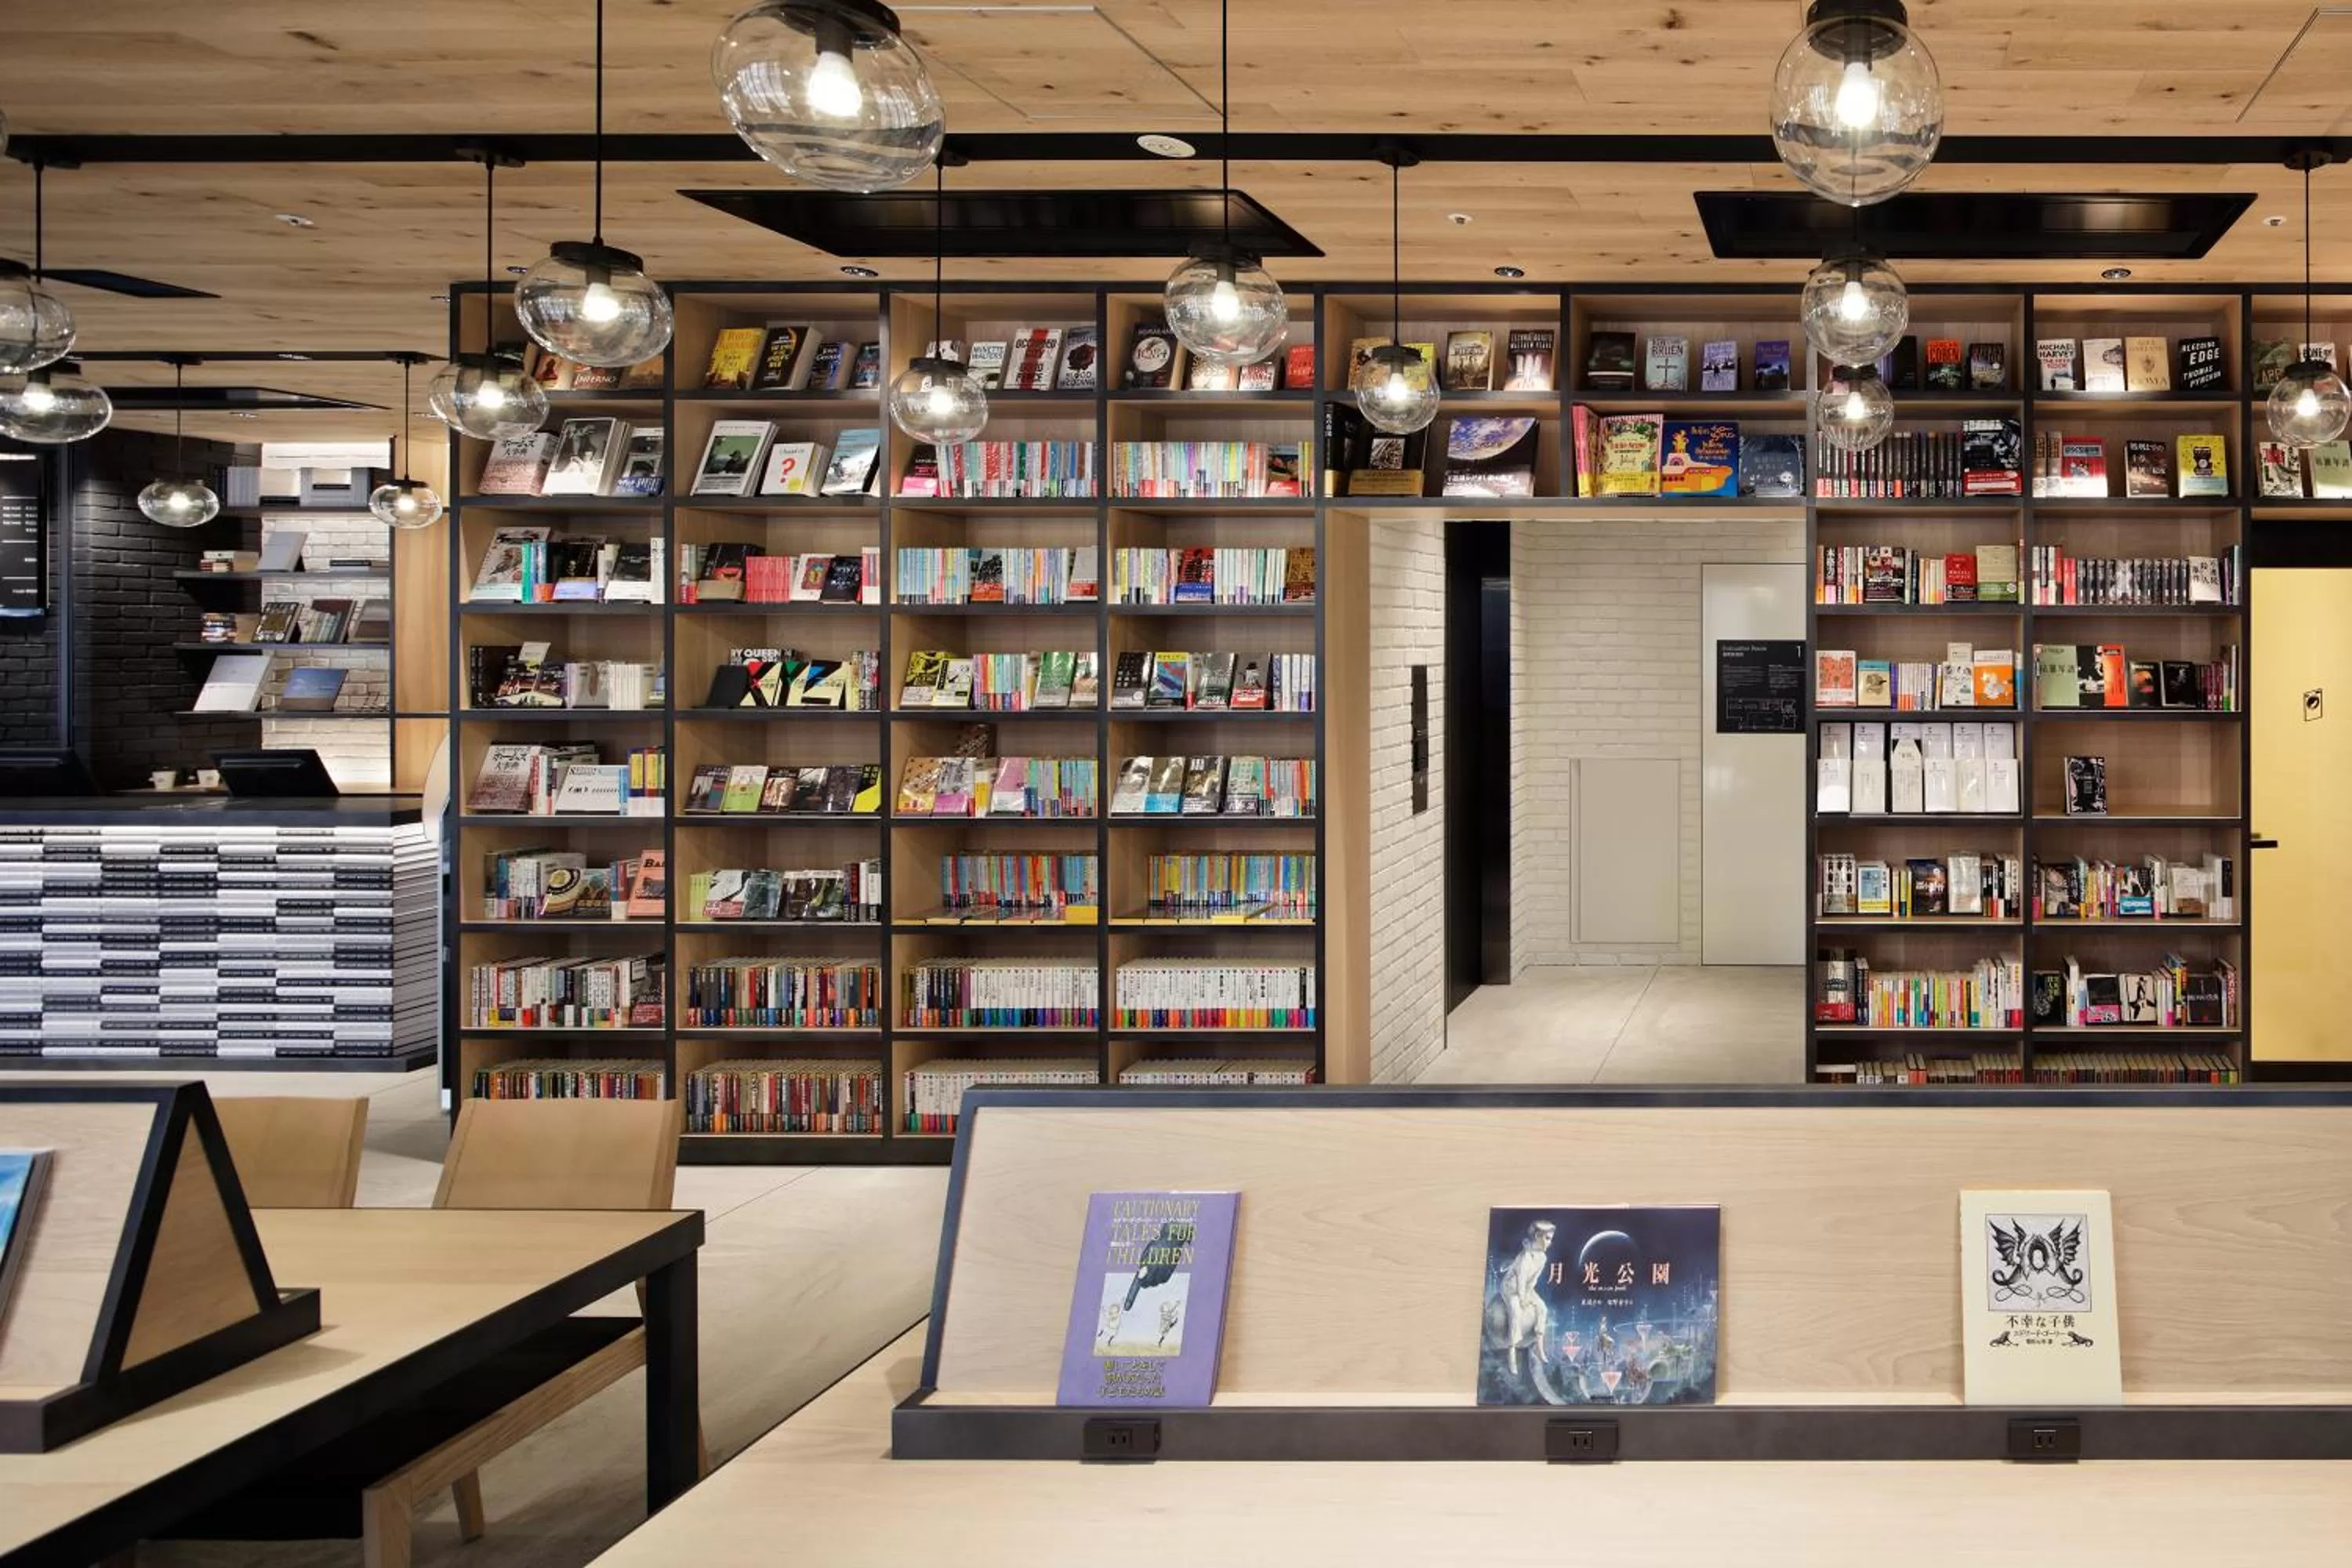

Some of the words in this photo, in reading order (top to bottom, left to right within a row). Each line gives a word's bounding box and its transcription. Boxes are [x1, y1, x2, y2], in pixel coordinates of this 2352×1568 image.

[2190, 347, 2220, 365] EDGE
[2183, 365, 2213, 380] THOMAS
[1112, 1200, 1200, 1218] CAUTIONARY
[1112, 1223, 1161, 1241] TALES
[1167, 1222, 1197, 1241] FOR
[1105, 1247, 1196, 1265] CHILDREN
[1547, 1261, 1671, 1286] 月光公園
[2006, 1314, 2075, 1328] 不幸な子供
